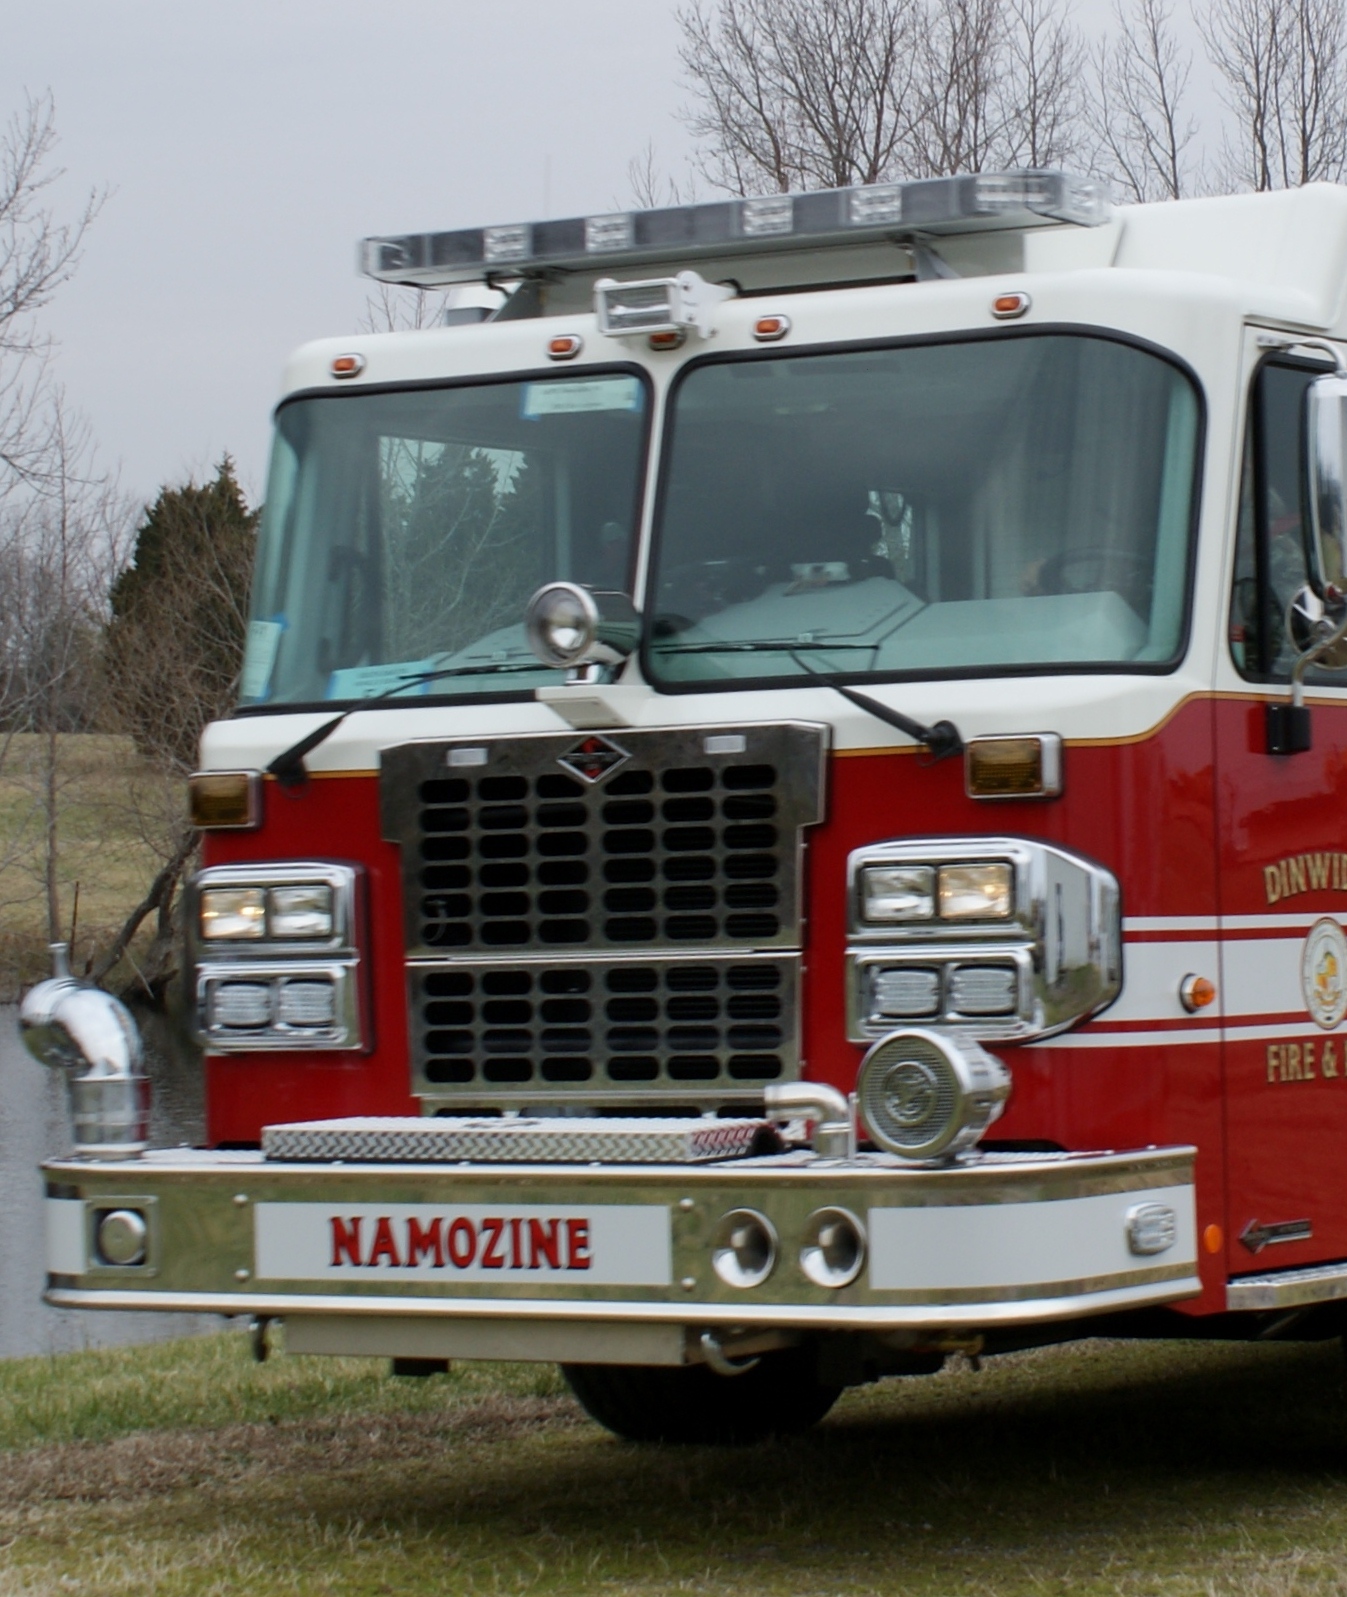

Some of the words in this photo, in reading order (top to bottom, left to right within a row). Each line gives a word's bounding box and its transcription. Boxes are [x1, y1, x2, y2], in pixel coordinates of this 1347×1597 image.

[1267, 1043, 1316, 1082] FIRE
[1321, 1041, 1338, 1079] &
[330, 1217, 591, 1270] NAMOZINE
